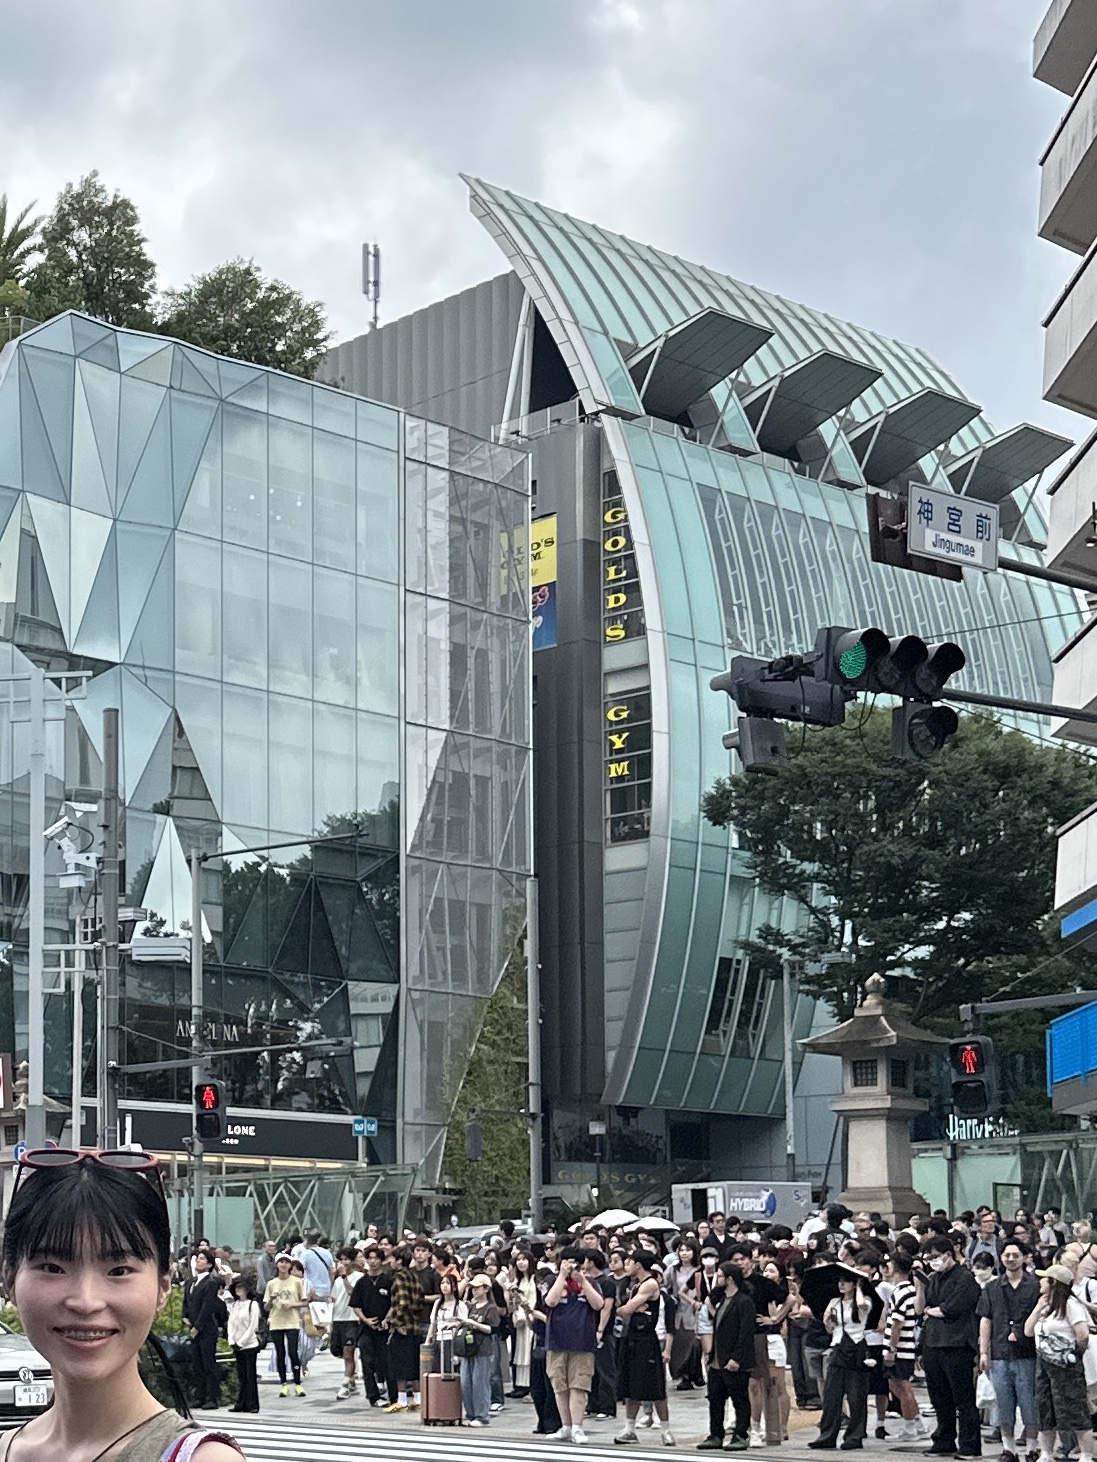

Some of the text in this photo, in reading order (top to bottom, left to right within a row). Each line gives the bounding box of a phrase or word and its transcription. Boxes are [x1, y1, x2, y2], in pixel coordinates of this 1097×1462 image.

[917, 496, 992, 542] 神宮前
[932, 533, 976, 558] Jingumae
[604, 507, 631, 778] GOLD'S GYM
